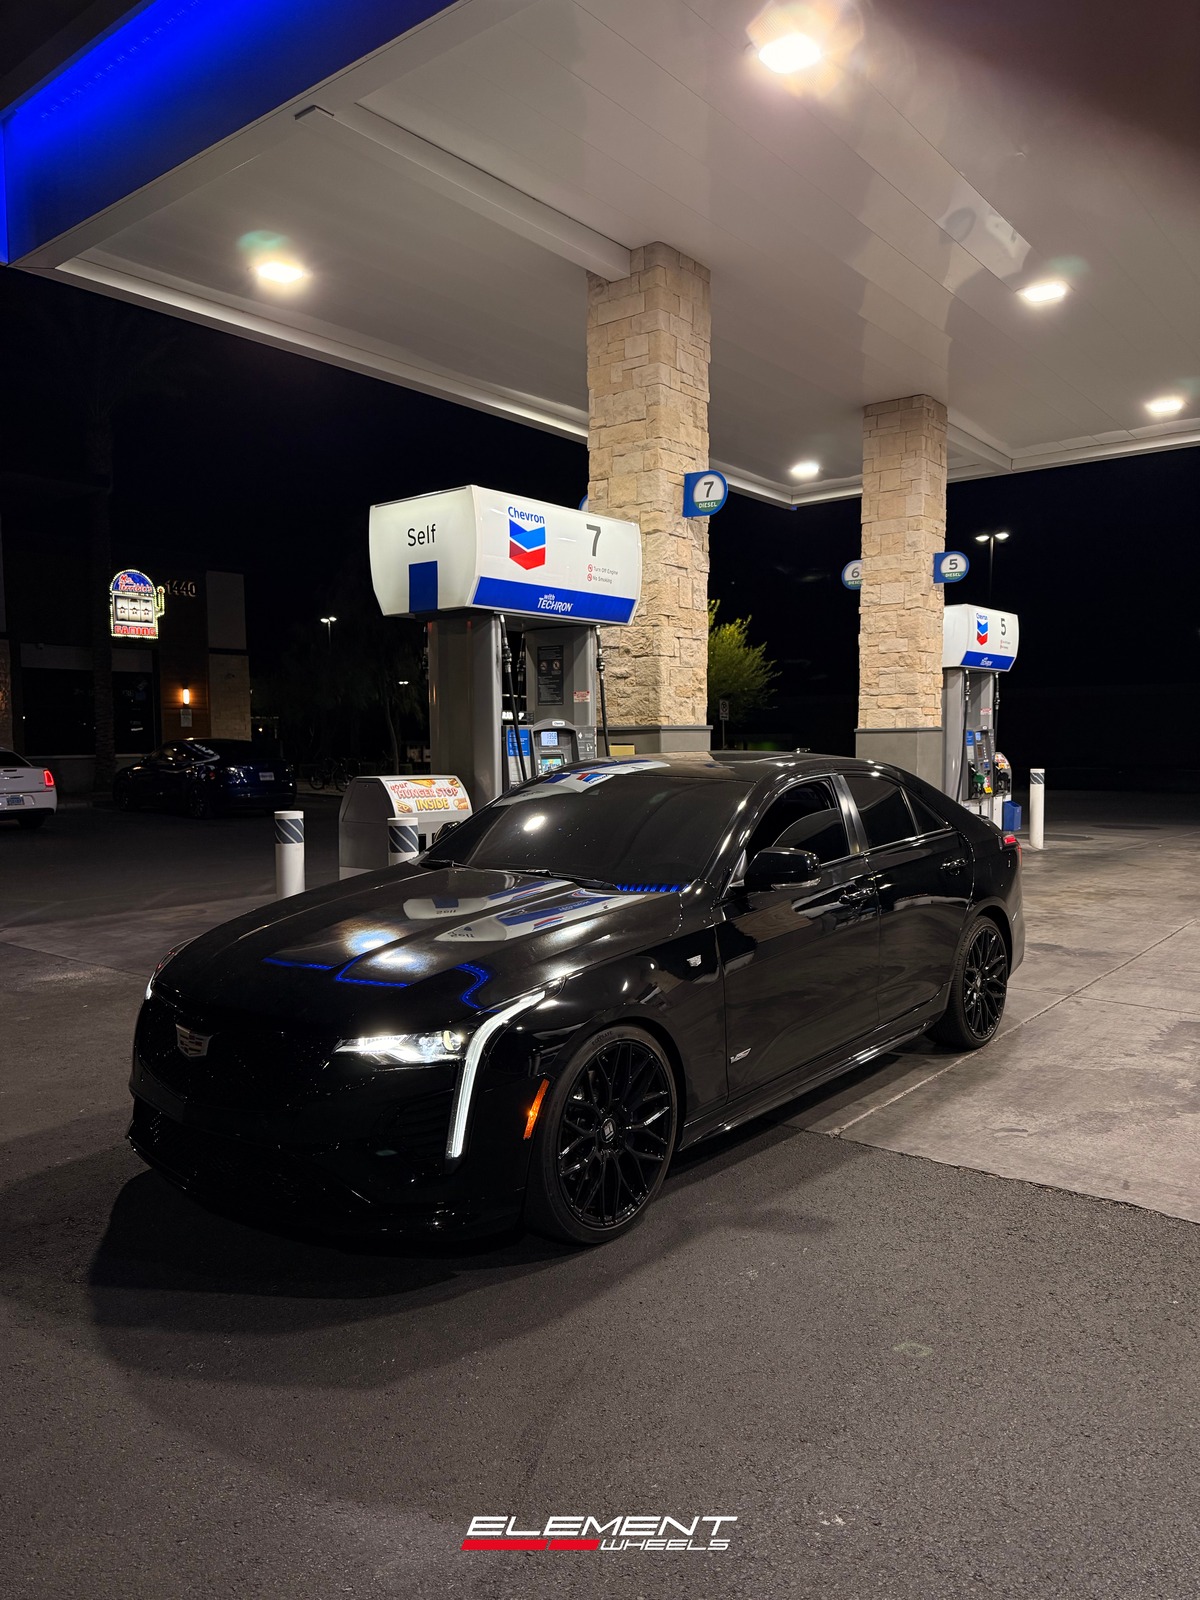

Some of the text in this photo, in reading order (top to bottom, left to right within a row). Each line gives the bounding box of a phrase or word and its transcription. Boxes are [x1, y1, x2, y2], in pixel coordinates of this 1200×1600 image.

[704, 481, 714, 498] 7
[699, 501, 717, 509] DIESEL
[508, 506, 545, 524] Chevron
[407, 524, 436, 546] Self
[586, 523, 601, 557] 7
[949, 558, 958, 570] 5
[851, 567, 860, 578] 6
[165, 580, 197, 597] 1440
[543, 593, 555, 601] with
[537, 597, 573, 612] TECHRON
[114, 625, 156, 636] GAMING
[1000, 617, 1007, 636] 5
[396, 786, 458, 799] HUNGER STOP
[415, 797, 450, 811] INSIDE
